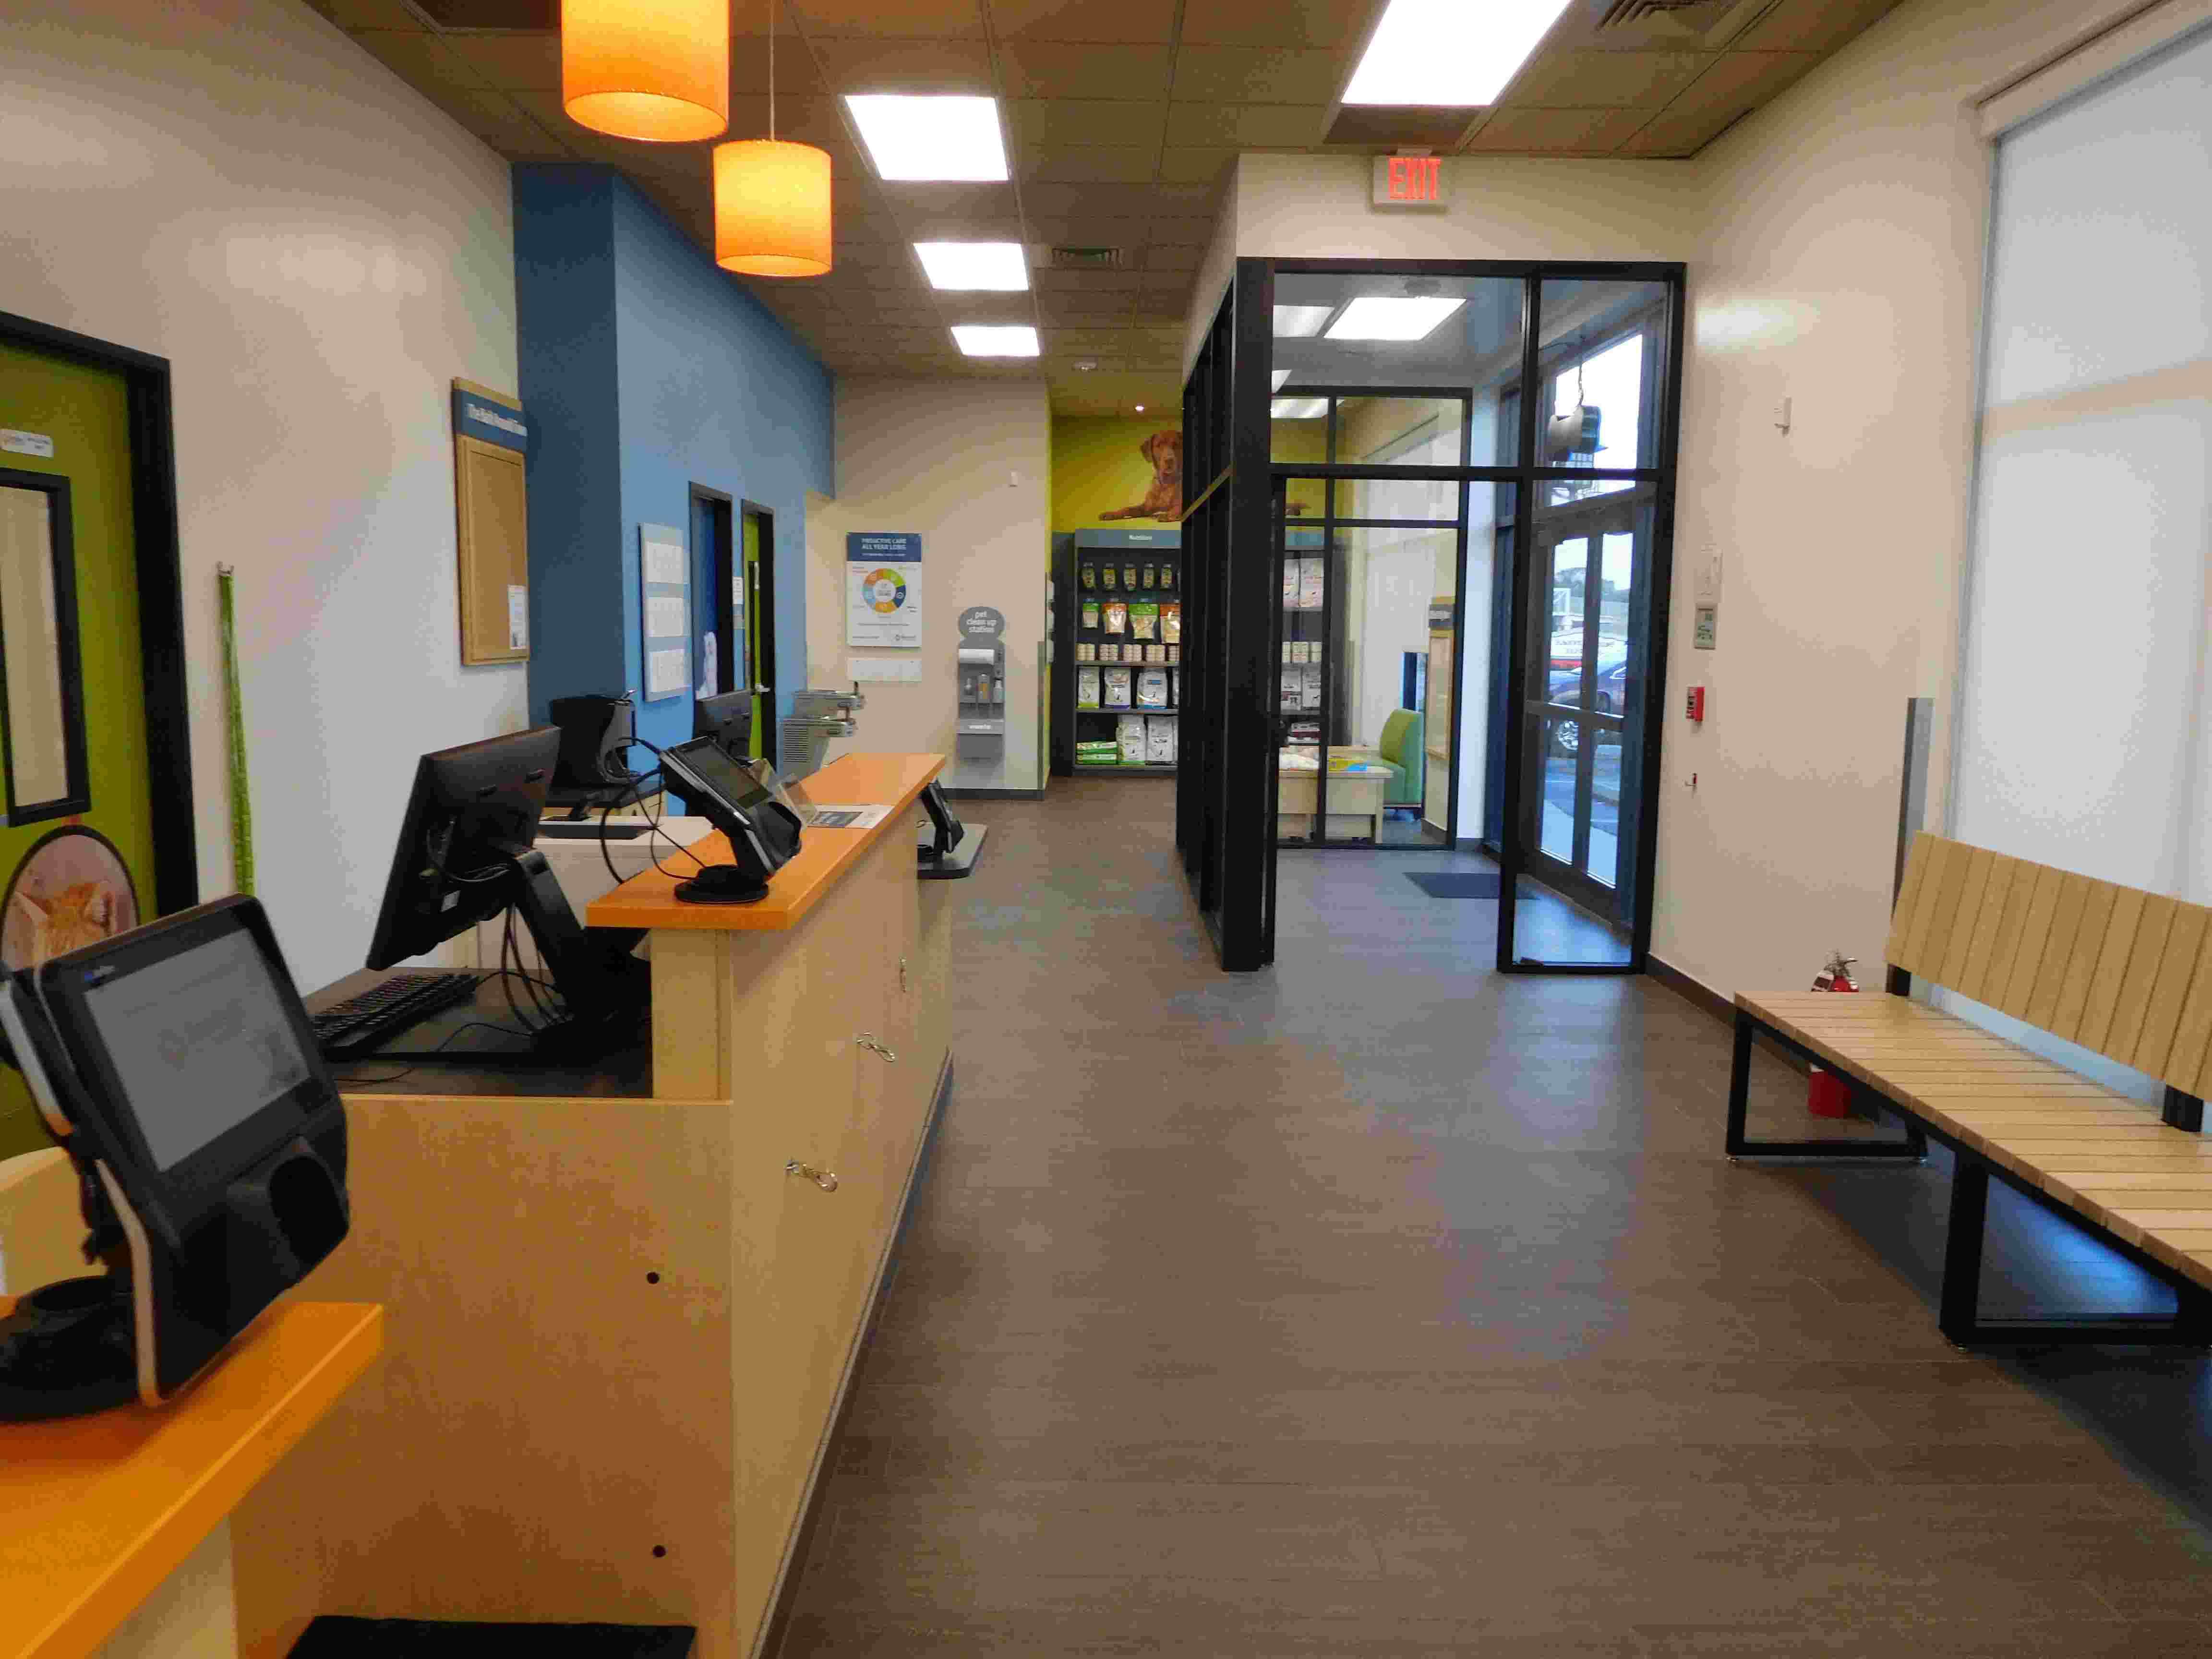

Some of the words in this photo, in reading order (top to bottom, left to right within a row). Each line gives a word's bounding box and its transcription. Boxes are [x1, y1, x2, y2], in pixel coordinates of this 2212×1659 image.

[1389, 157, 1441, 200] EXIT
[975, 610, 987, 619] pet
[968, 625, 995, 633] station
